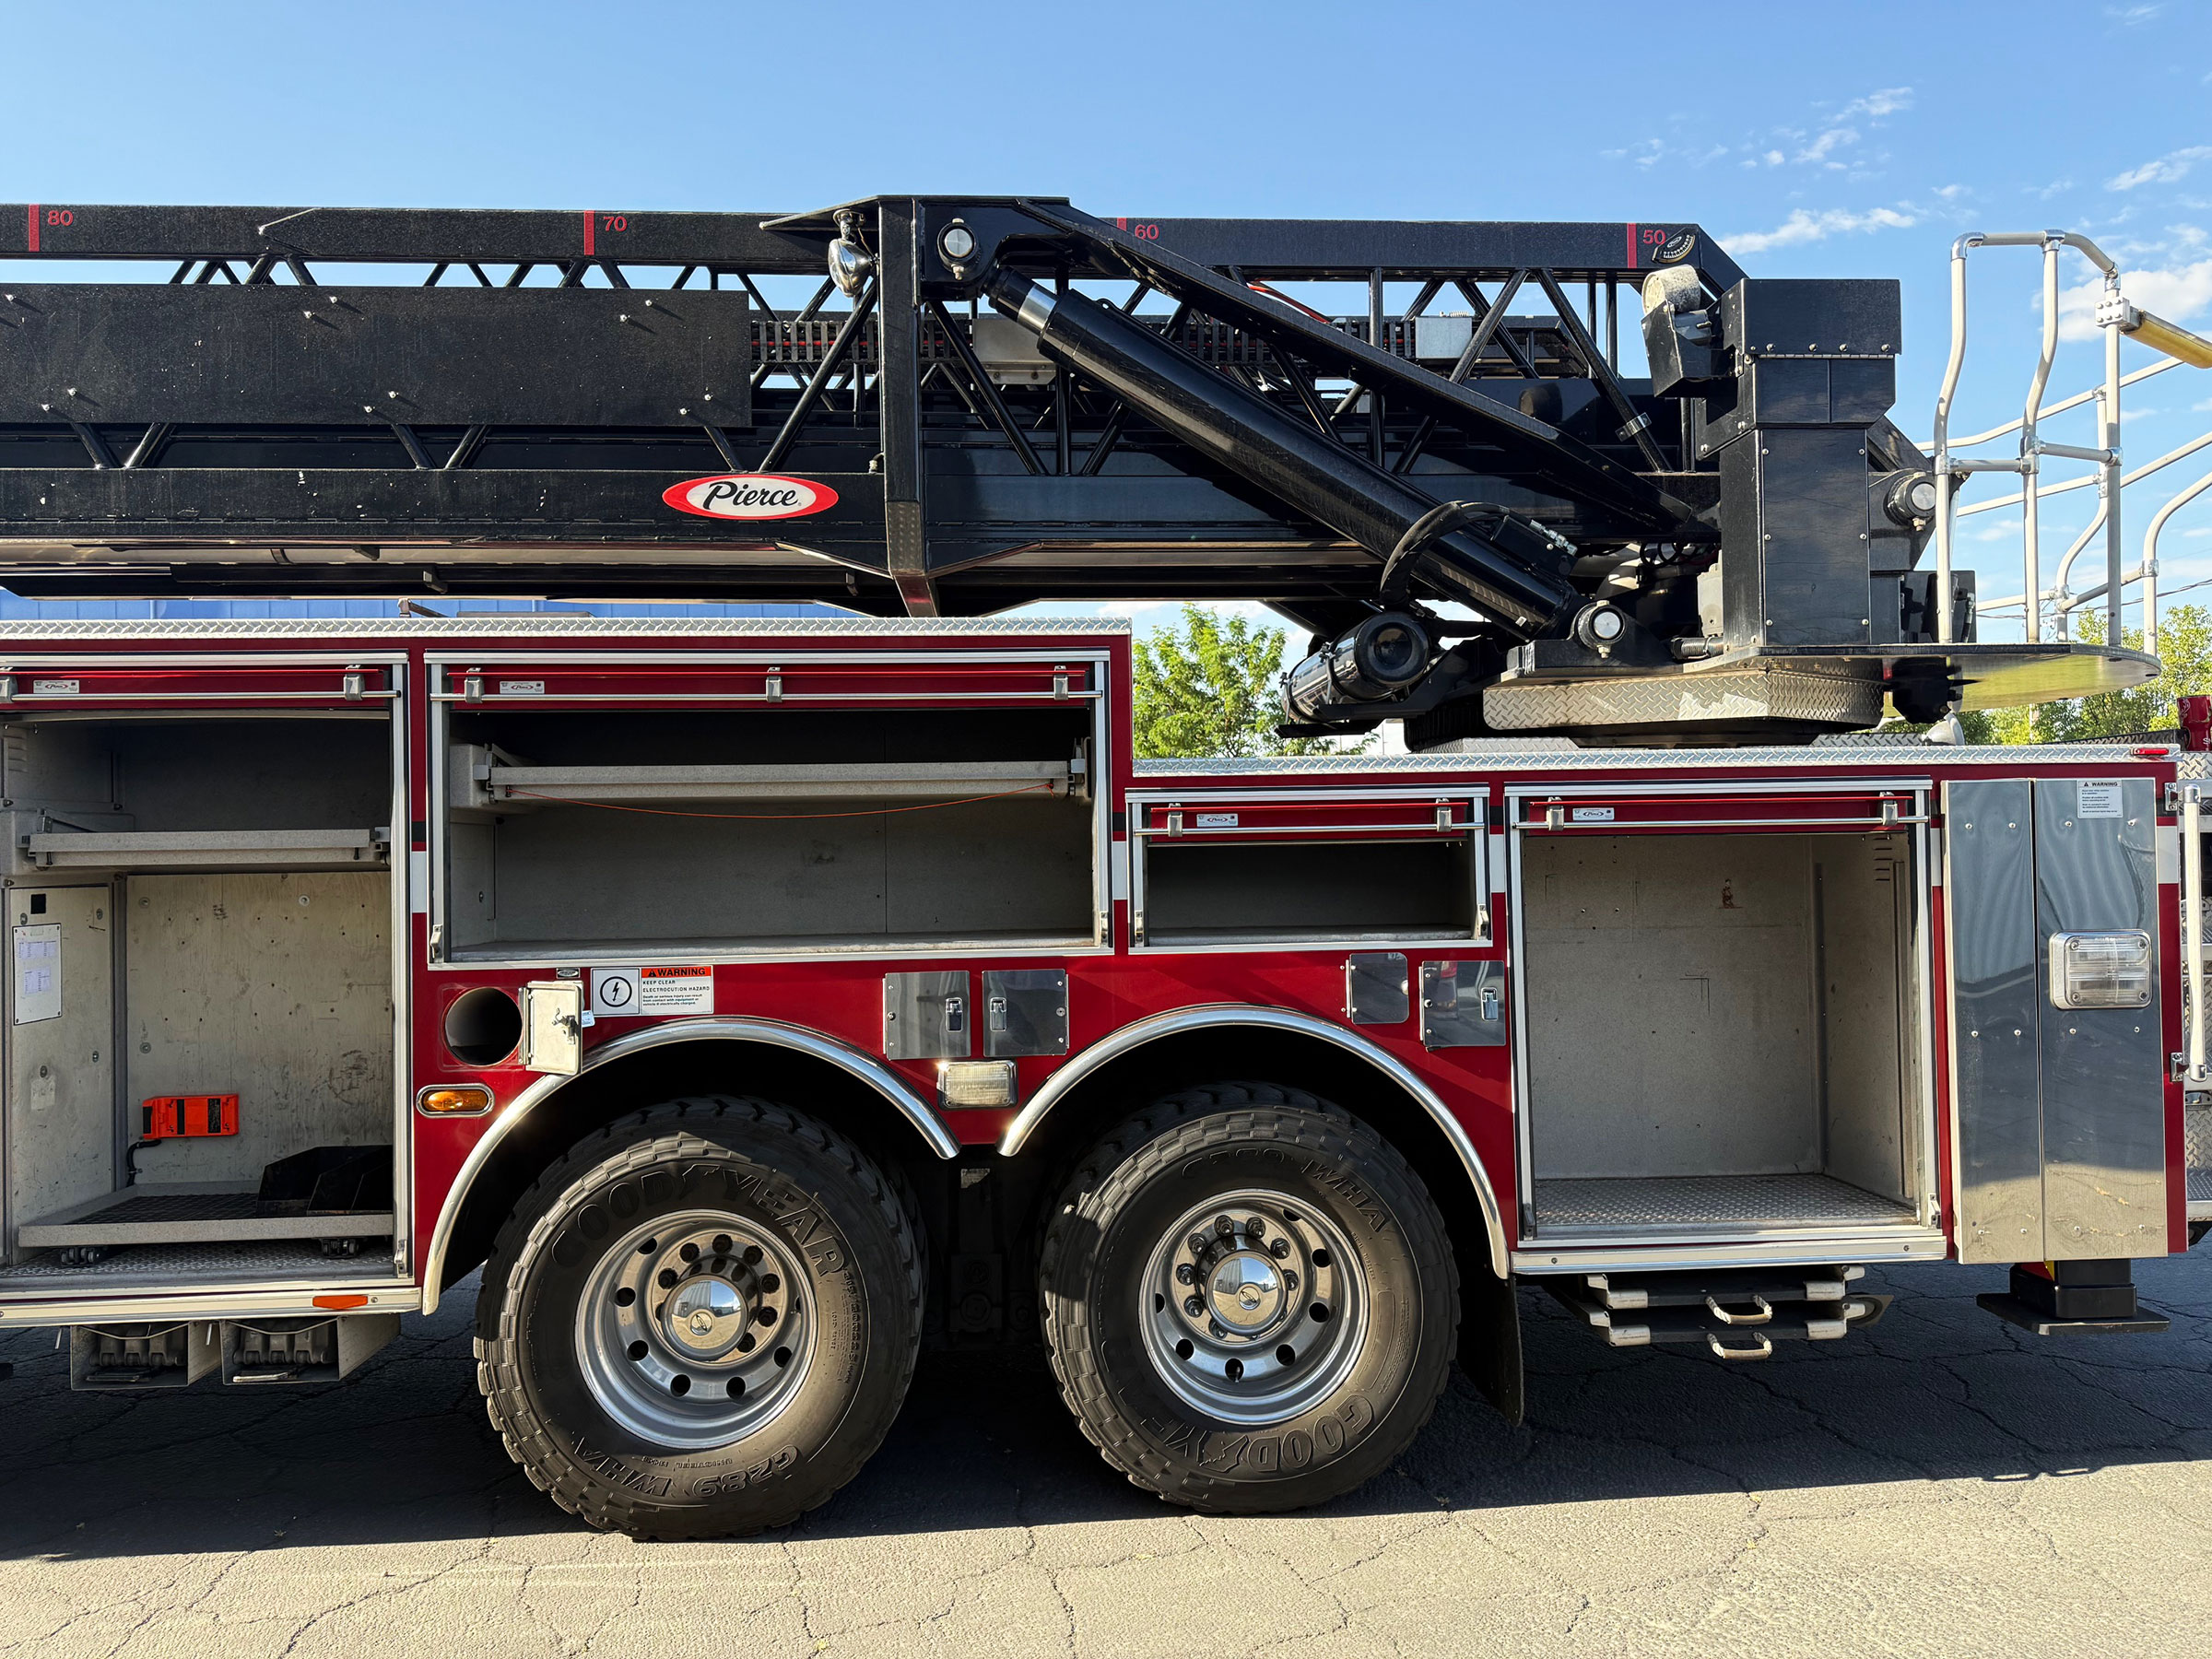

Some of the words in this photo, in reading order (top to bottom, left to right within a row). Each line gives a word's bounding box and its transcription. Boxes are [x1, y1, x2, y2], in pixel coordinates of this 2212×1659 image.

[48, 211, 73, 226] 80
[604, 217, 627, 231] 70
[1135, 225, 1159, 240] 60
[1643, 229, 1666, 245] 50
[702, 481, 798, 510] Pierce
[657, 968, 706, 976] WARNING
[1300, 1159, 1390, 1233] WHA
[573, 1436, 673, 1497] WHA
[692, 1444, 798, 1498] G289
